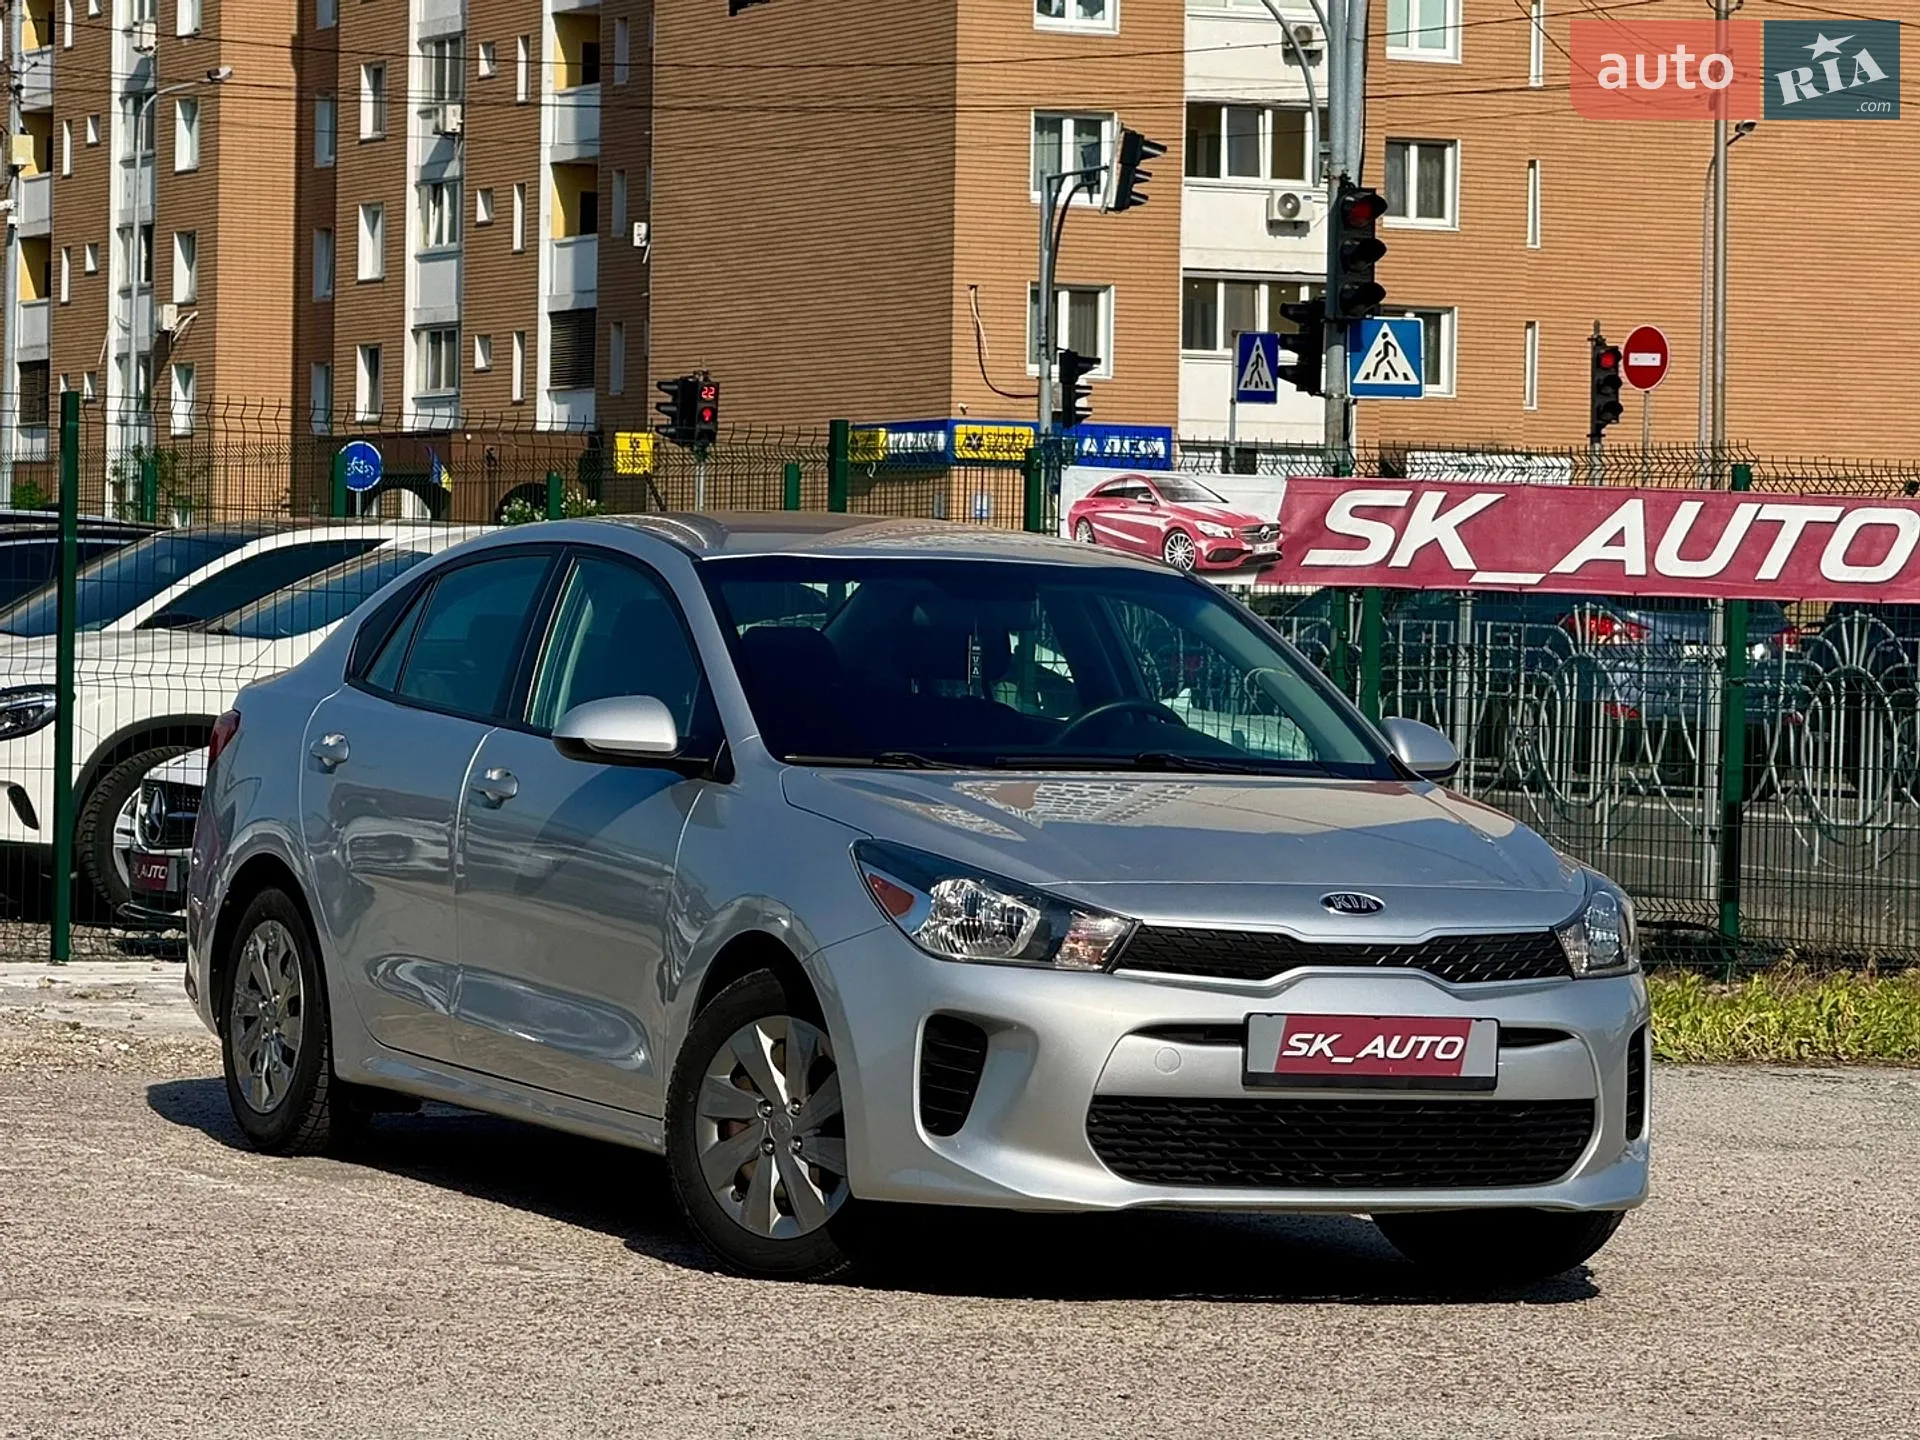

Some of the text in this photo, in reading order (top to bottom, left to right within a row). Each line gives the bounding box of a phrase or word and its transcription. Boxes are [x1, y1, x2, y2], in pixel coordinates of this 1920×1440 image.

[701, 386, 716, 399] 22
[1300, 489, 1920, 584] SK_AUTO
[1330, 895, 1377, 910] KIA
[1282, 1033, 1465, 1063] SK_AUTO
